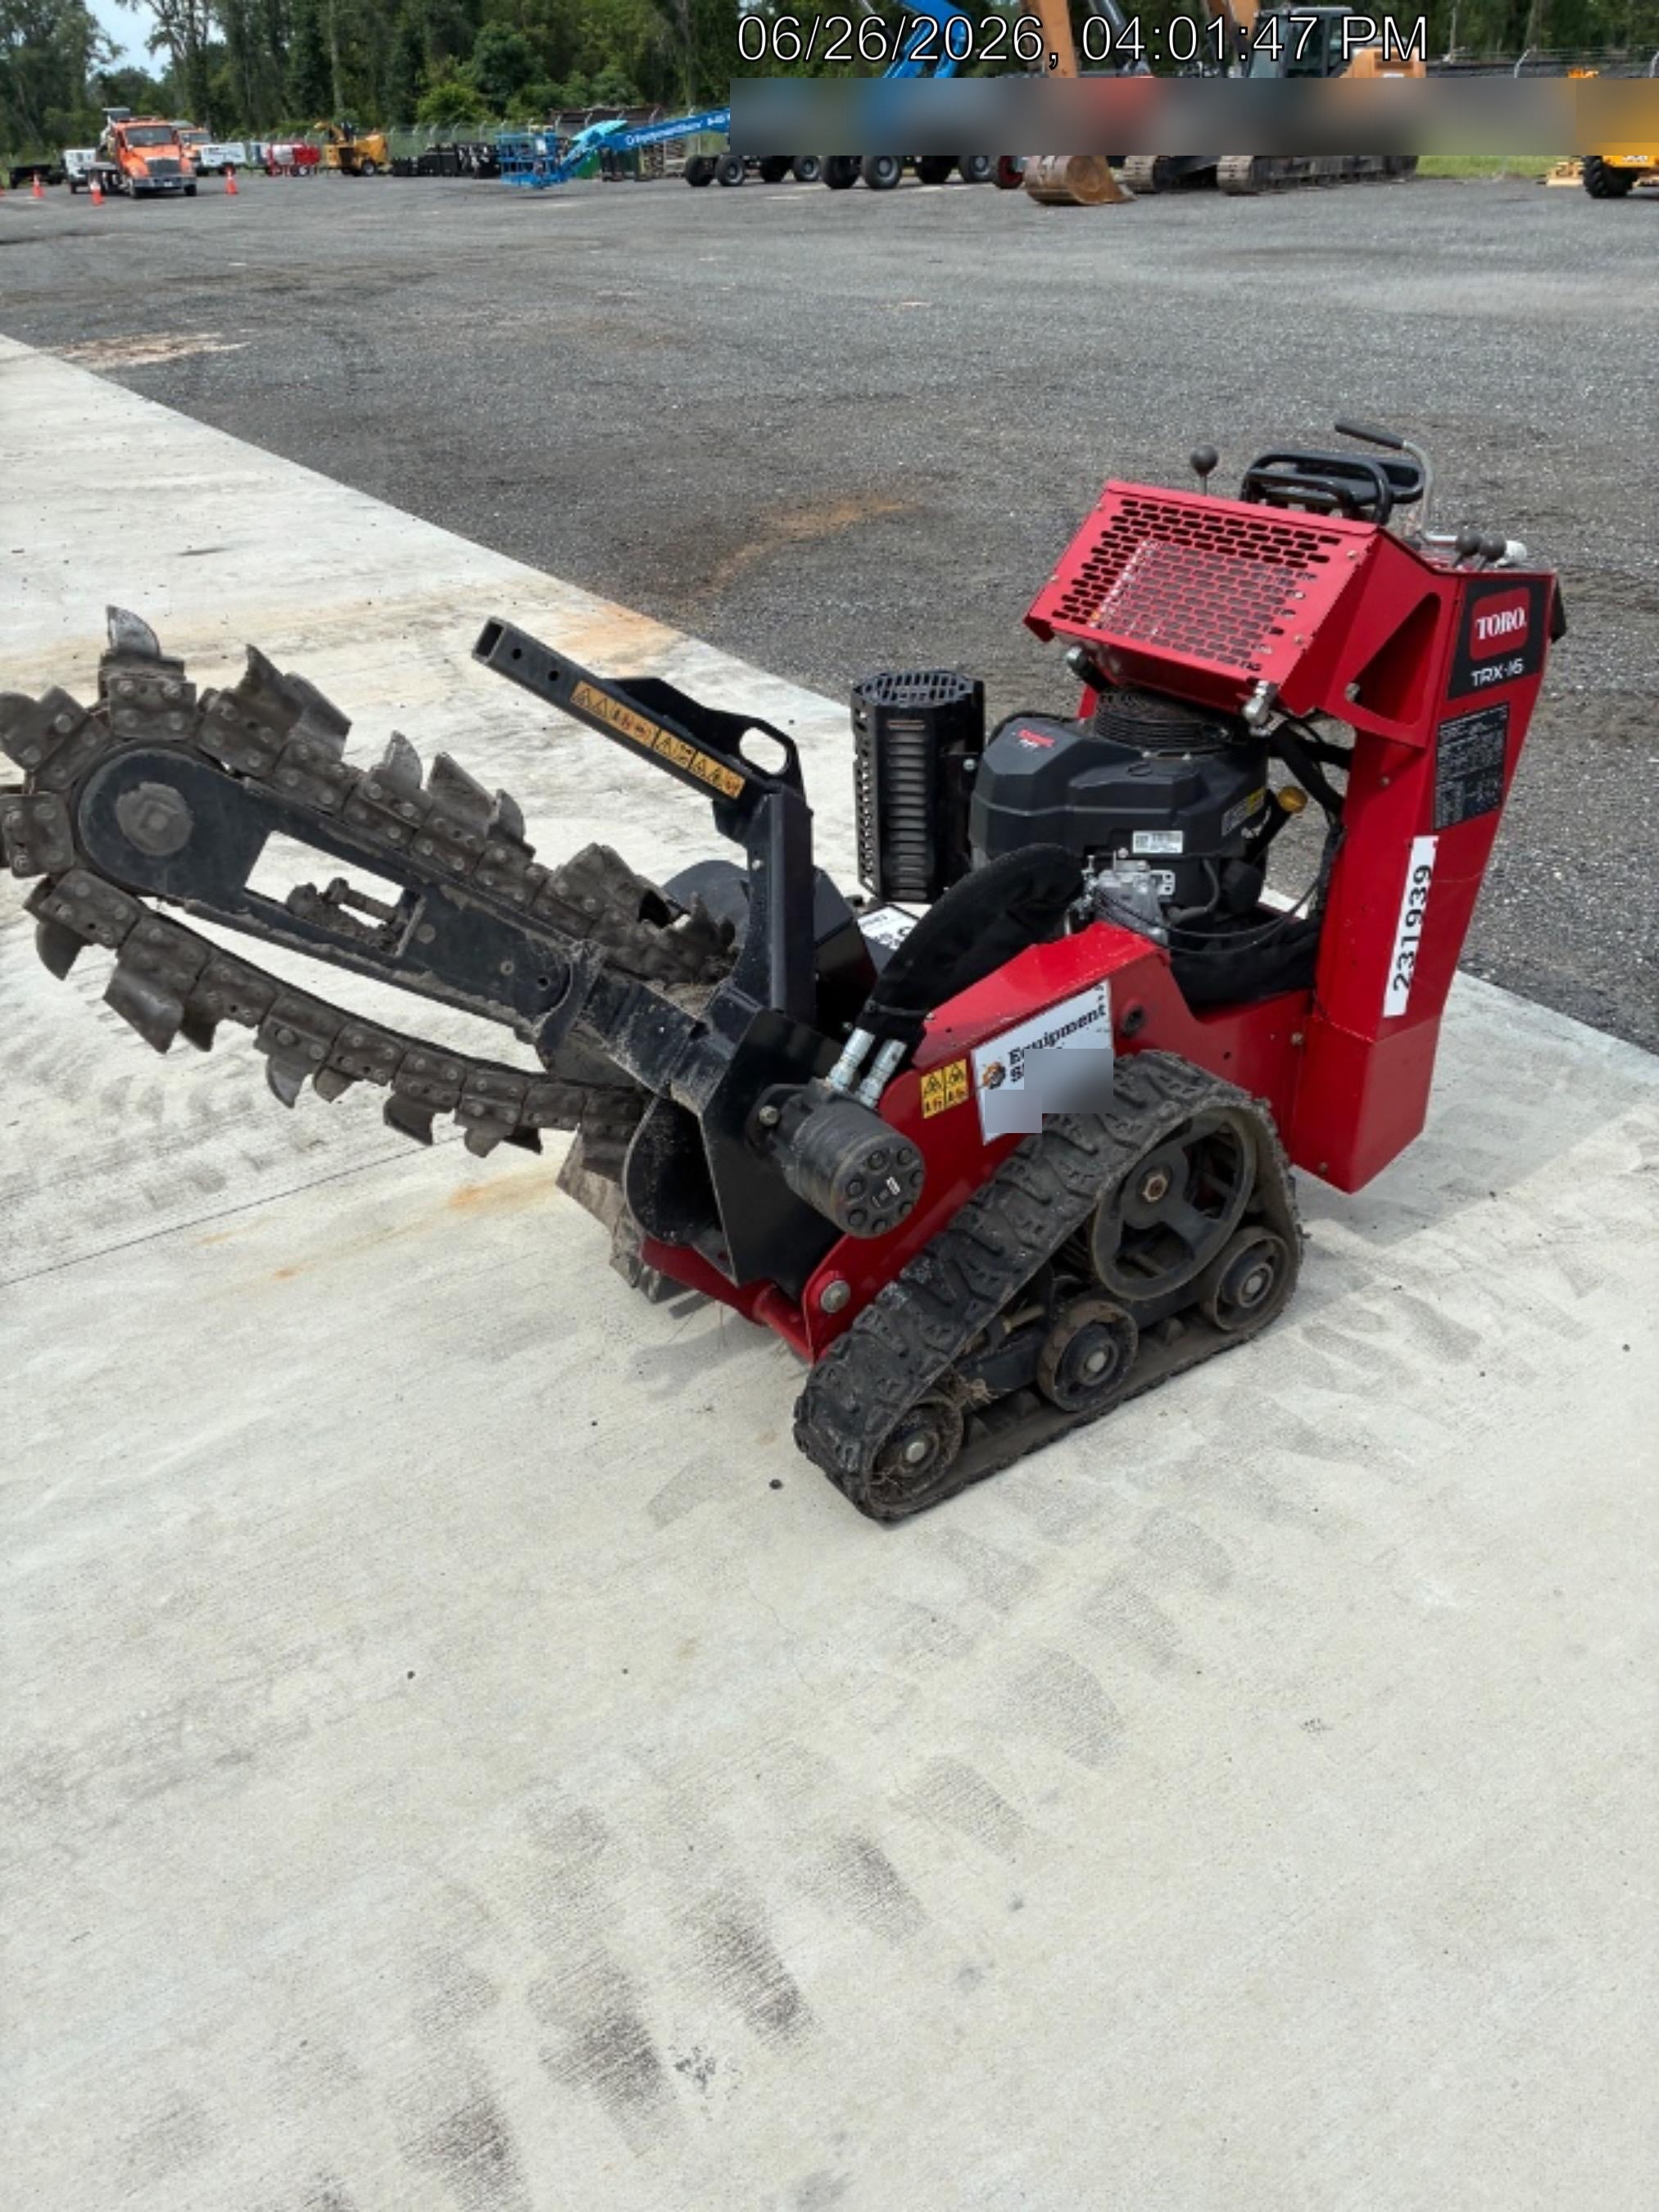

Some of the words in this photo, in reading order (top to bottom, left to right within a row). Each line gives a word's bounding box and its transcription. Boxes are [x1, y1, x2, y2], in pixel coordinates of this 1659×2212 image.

[1475, 606, 1525, 640] TORO
[1470, 658, 1524, 687] TRX-16
[1393, 864, 1433, 991] 231939
